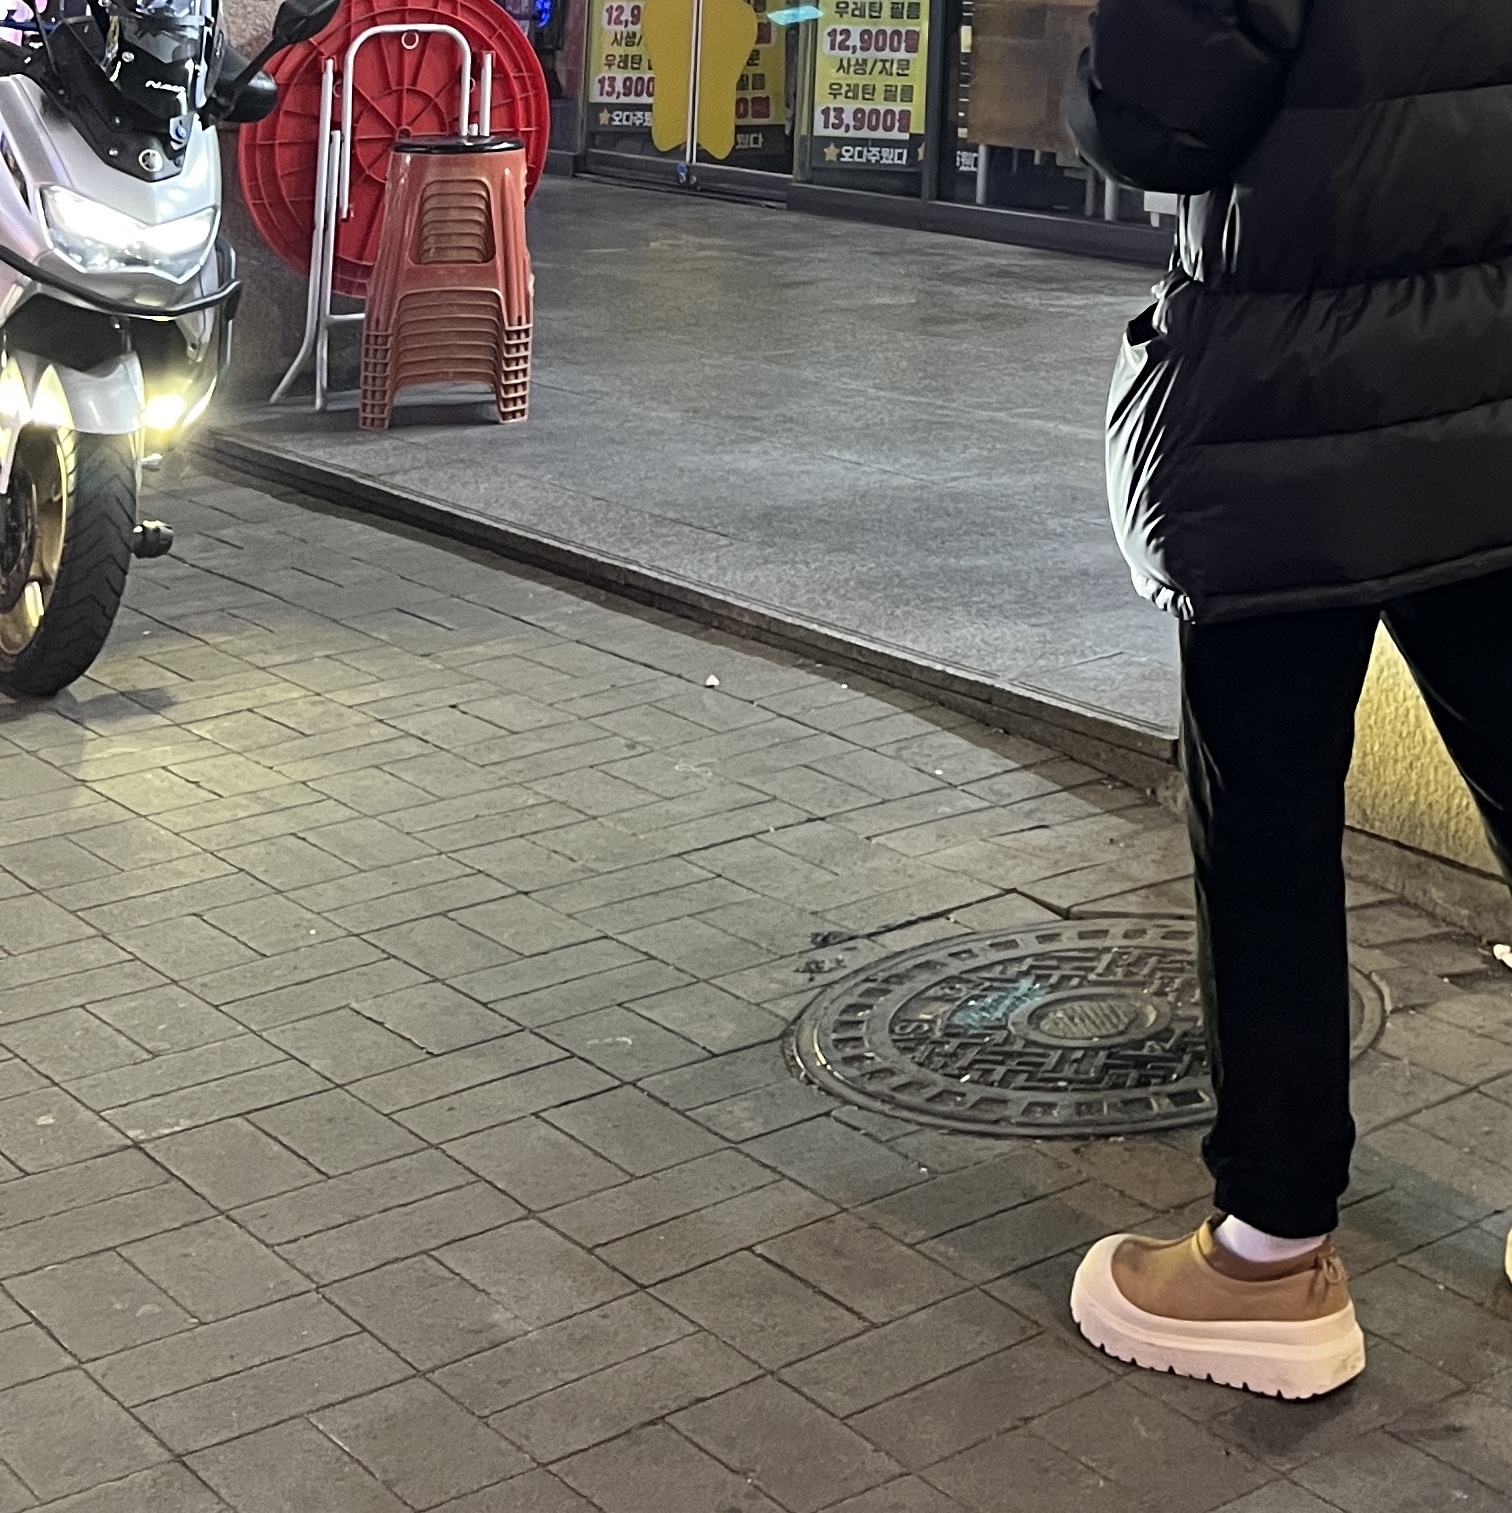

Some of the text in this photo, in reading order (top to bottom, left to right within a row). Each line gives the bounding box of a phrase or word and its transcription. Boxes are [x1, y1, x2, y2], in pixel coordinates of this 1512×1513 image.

[834, 1, 883, 19] 우레탄
[835, 58, 910, 77] 사생/지문
[828, 82, 876, 101] 우레탄
